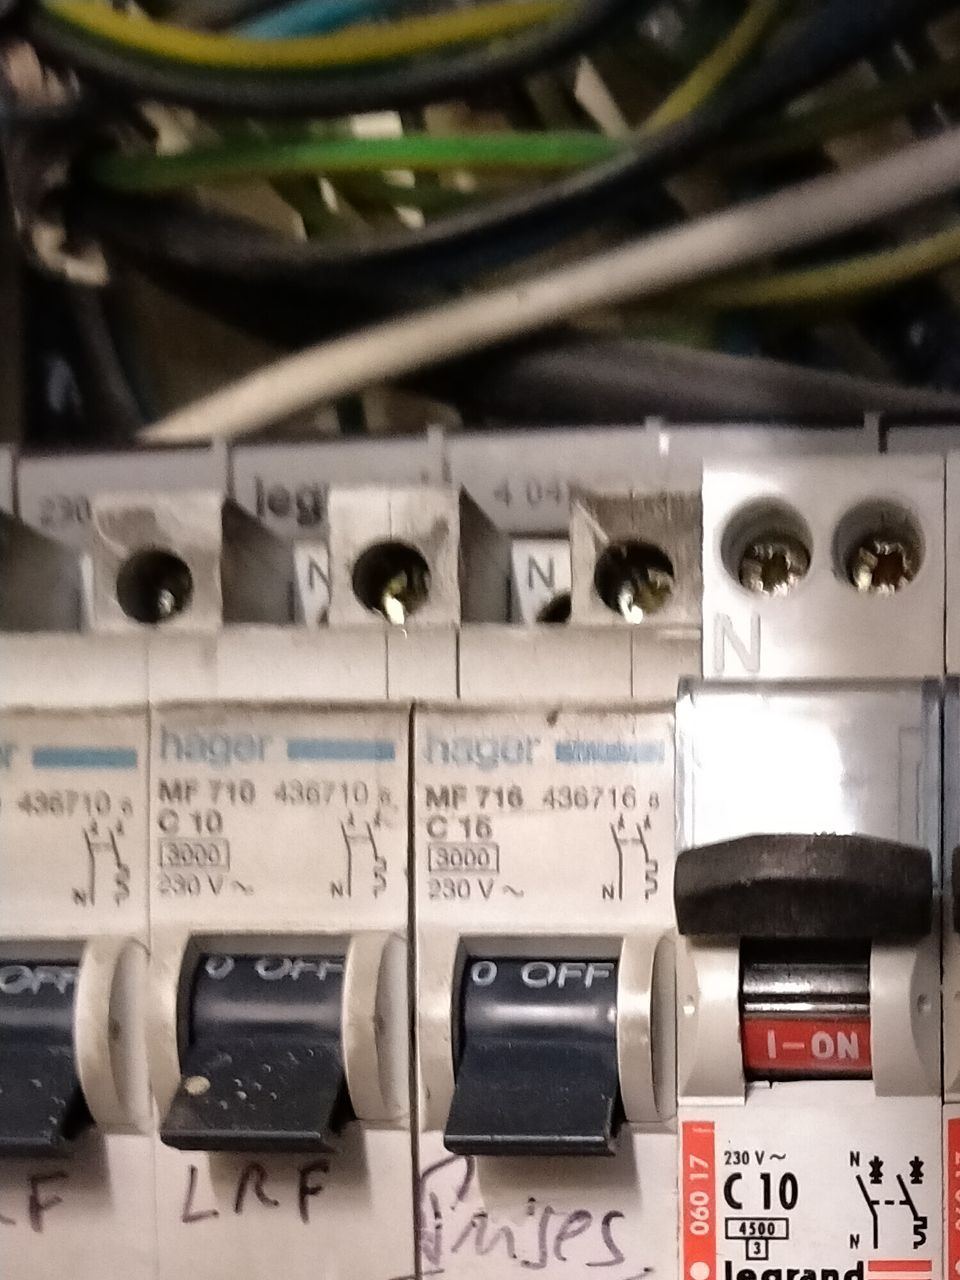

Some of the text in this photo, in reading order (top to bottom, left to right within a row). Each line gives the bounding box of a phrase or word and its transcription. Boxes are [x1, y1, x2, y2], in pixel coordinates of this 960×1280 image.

[527, 554, 555, 591] N
[712, 611, 760, 674] N
[160, 724, 273, 771] hager
[158, 777, 199, 805] MF
[208, 778, 257, 805] 710
[424, 783, 468, 809] MF
[189, 807, 224, 834] 10
[426, 814, 492, 840] C 16
[166, 841, 221, 867] 3000
[436, 846, 491, 869] 3000
[428, 878, 471, 901] 230
[601, 882, 615, 900] N
[520, 960, 615, 989] OFF
[724, 1150, 750, 1165] 230
[850, 1151, 860, 1167] N
[690, 1154, 710, 1236] 060 17
[738, 1221, 776, 1236] 4500
[850, 1234, 860, 1249] N
[753, 1241, 762, 1255] 3
